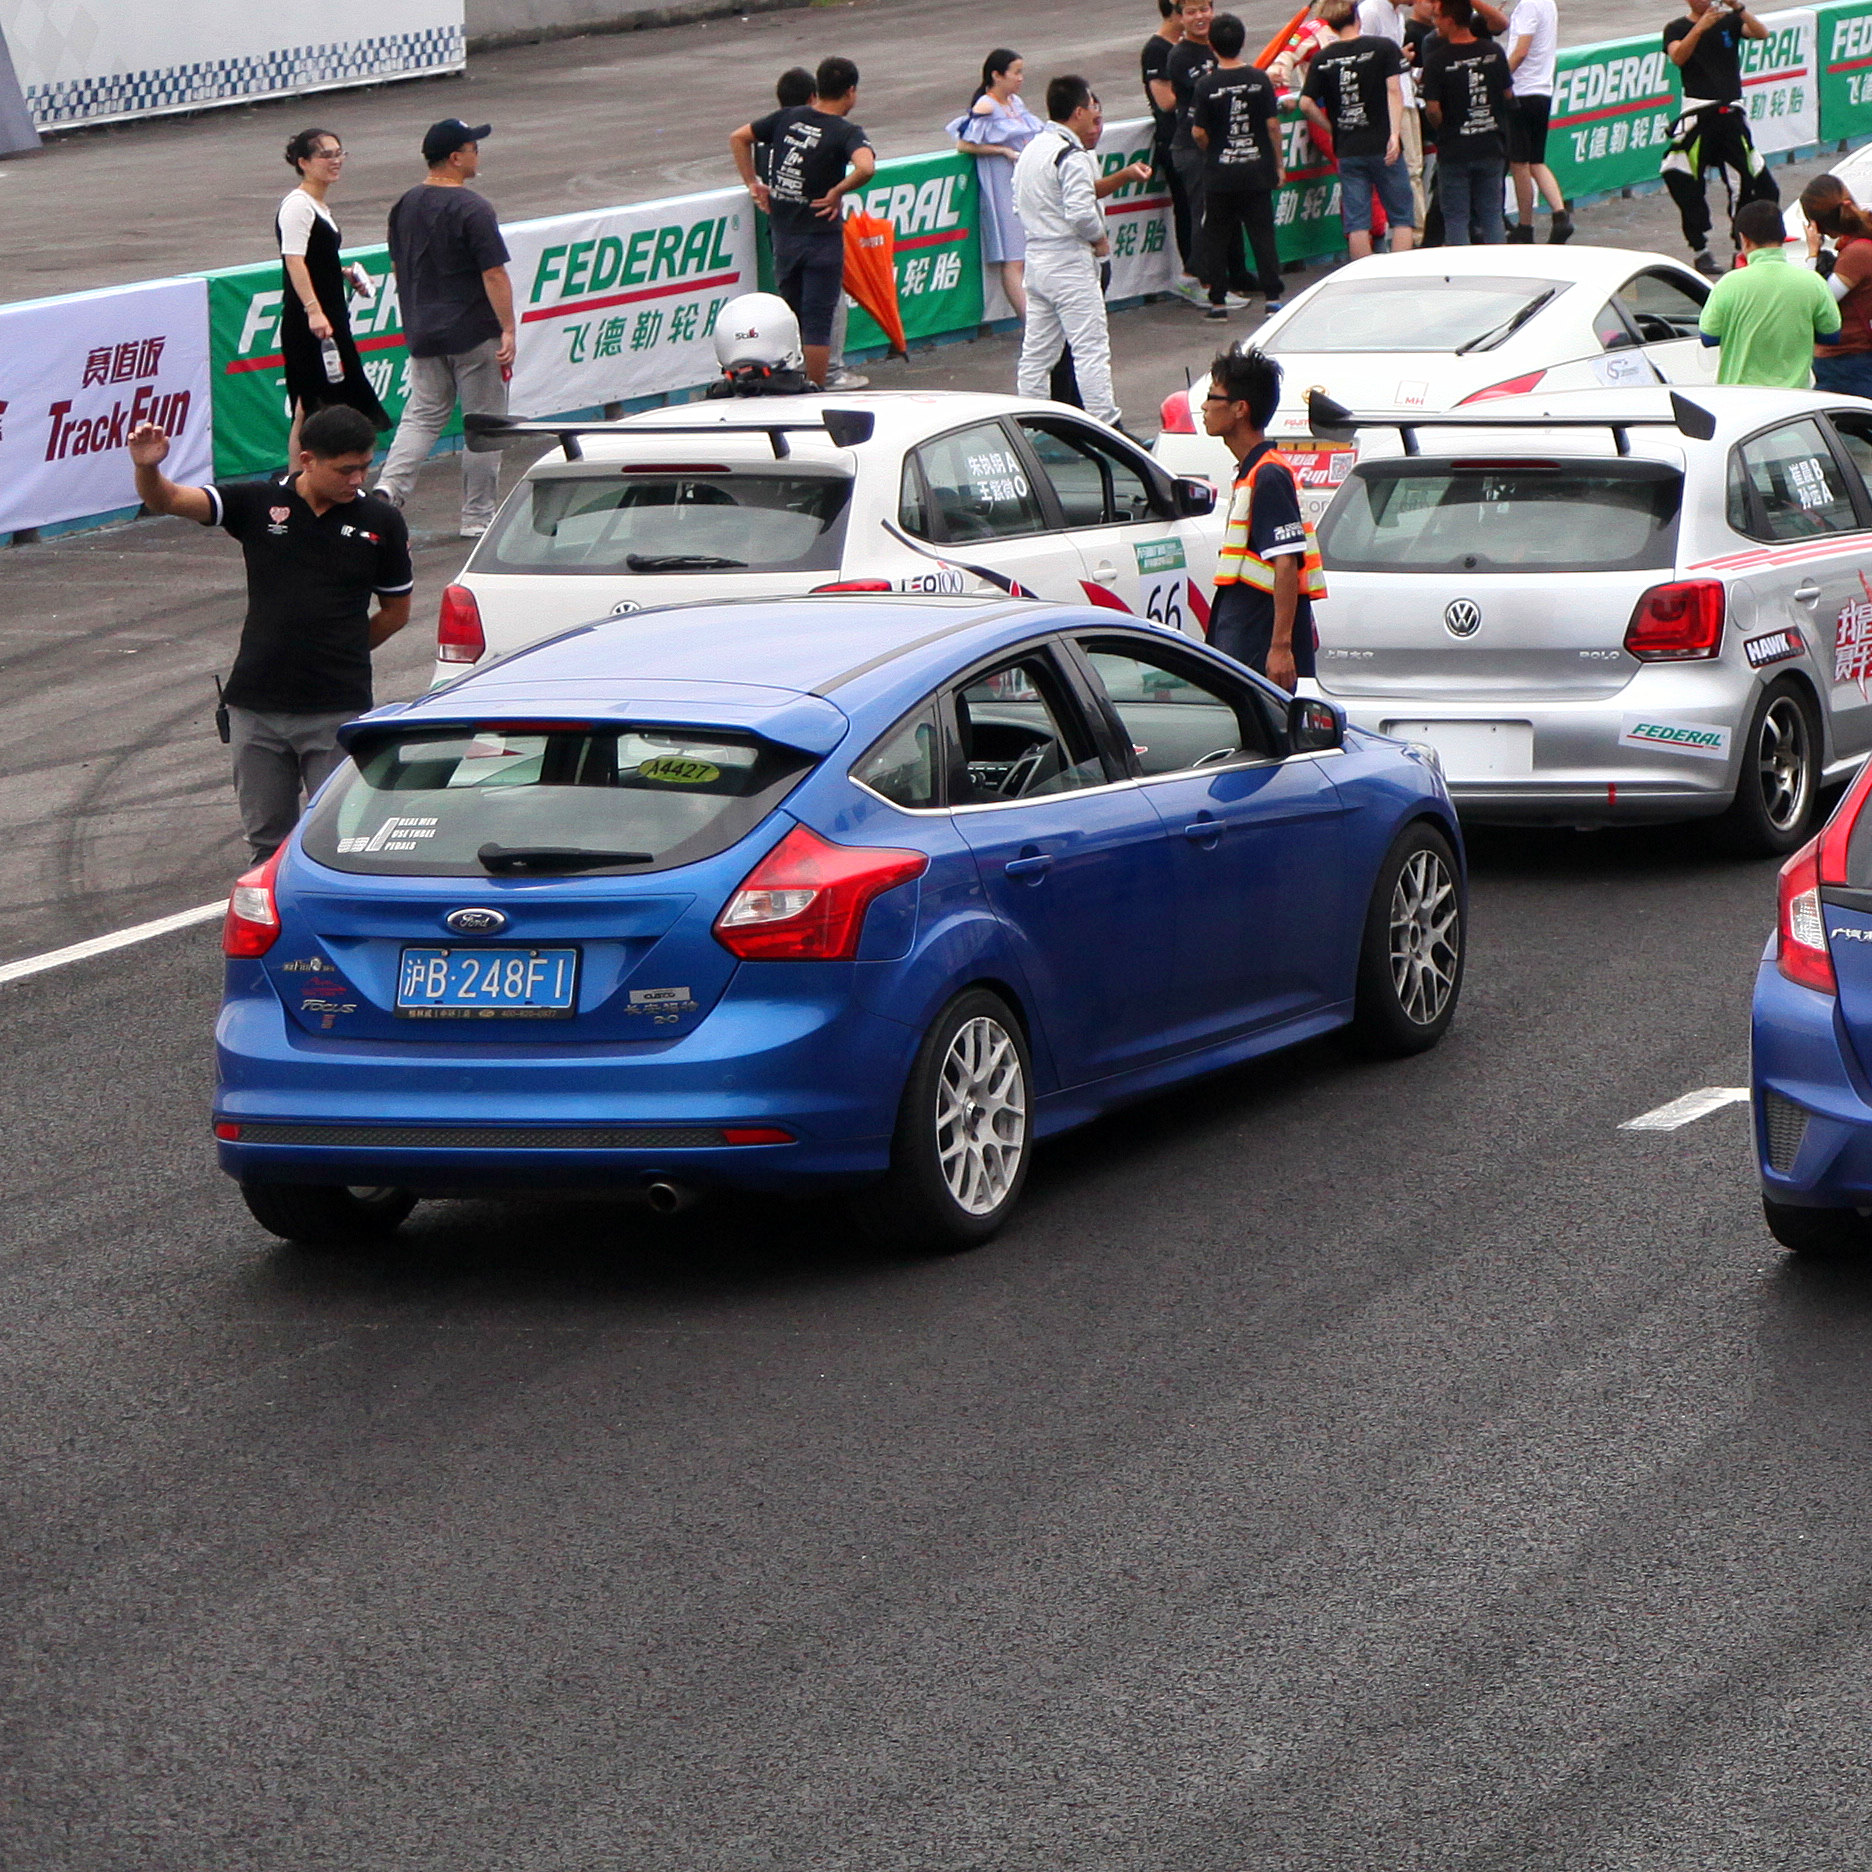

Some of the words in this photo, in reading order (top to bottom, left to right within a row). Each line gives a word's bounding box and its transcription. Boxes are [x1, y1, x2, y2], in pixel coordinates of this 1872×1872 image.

[1551, 50, 1674, 116] FEDERAL
[1570, 118, 1672, 163] 飞德勒轮胎
[529, 217, 734, 304] FEDERAL
[81, 335, 167, 390] 赛道饭
[44, 383, 191, 462] TrackFun
[1146, 580, 1183, 631] 66
[1579, 649, 1621, 661] POLO
[1745, 631, 1791, 662] HAWK
[1631, 722, 1723, 748] FEDERAL
[643, 756, 710, 784] A4427
[391, 829, 410, 839] USE
[398, 817, 418, 826] REAL
[419, 817, 439, 826] MEN
[459, 913, 491, 928] Ford
[300, 998, 357, 1014] FOCUS
